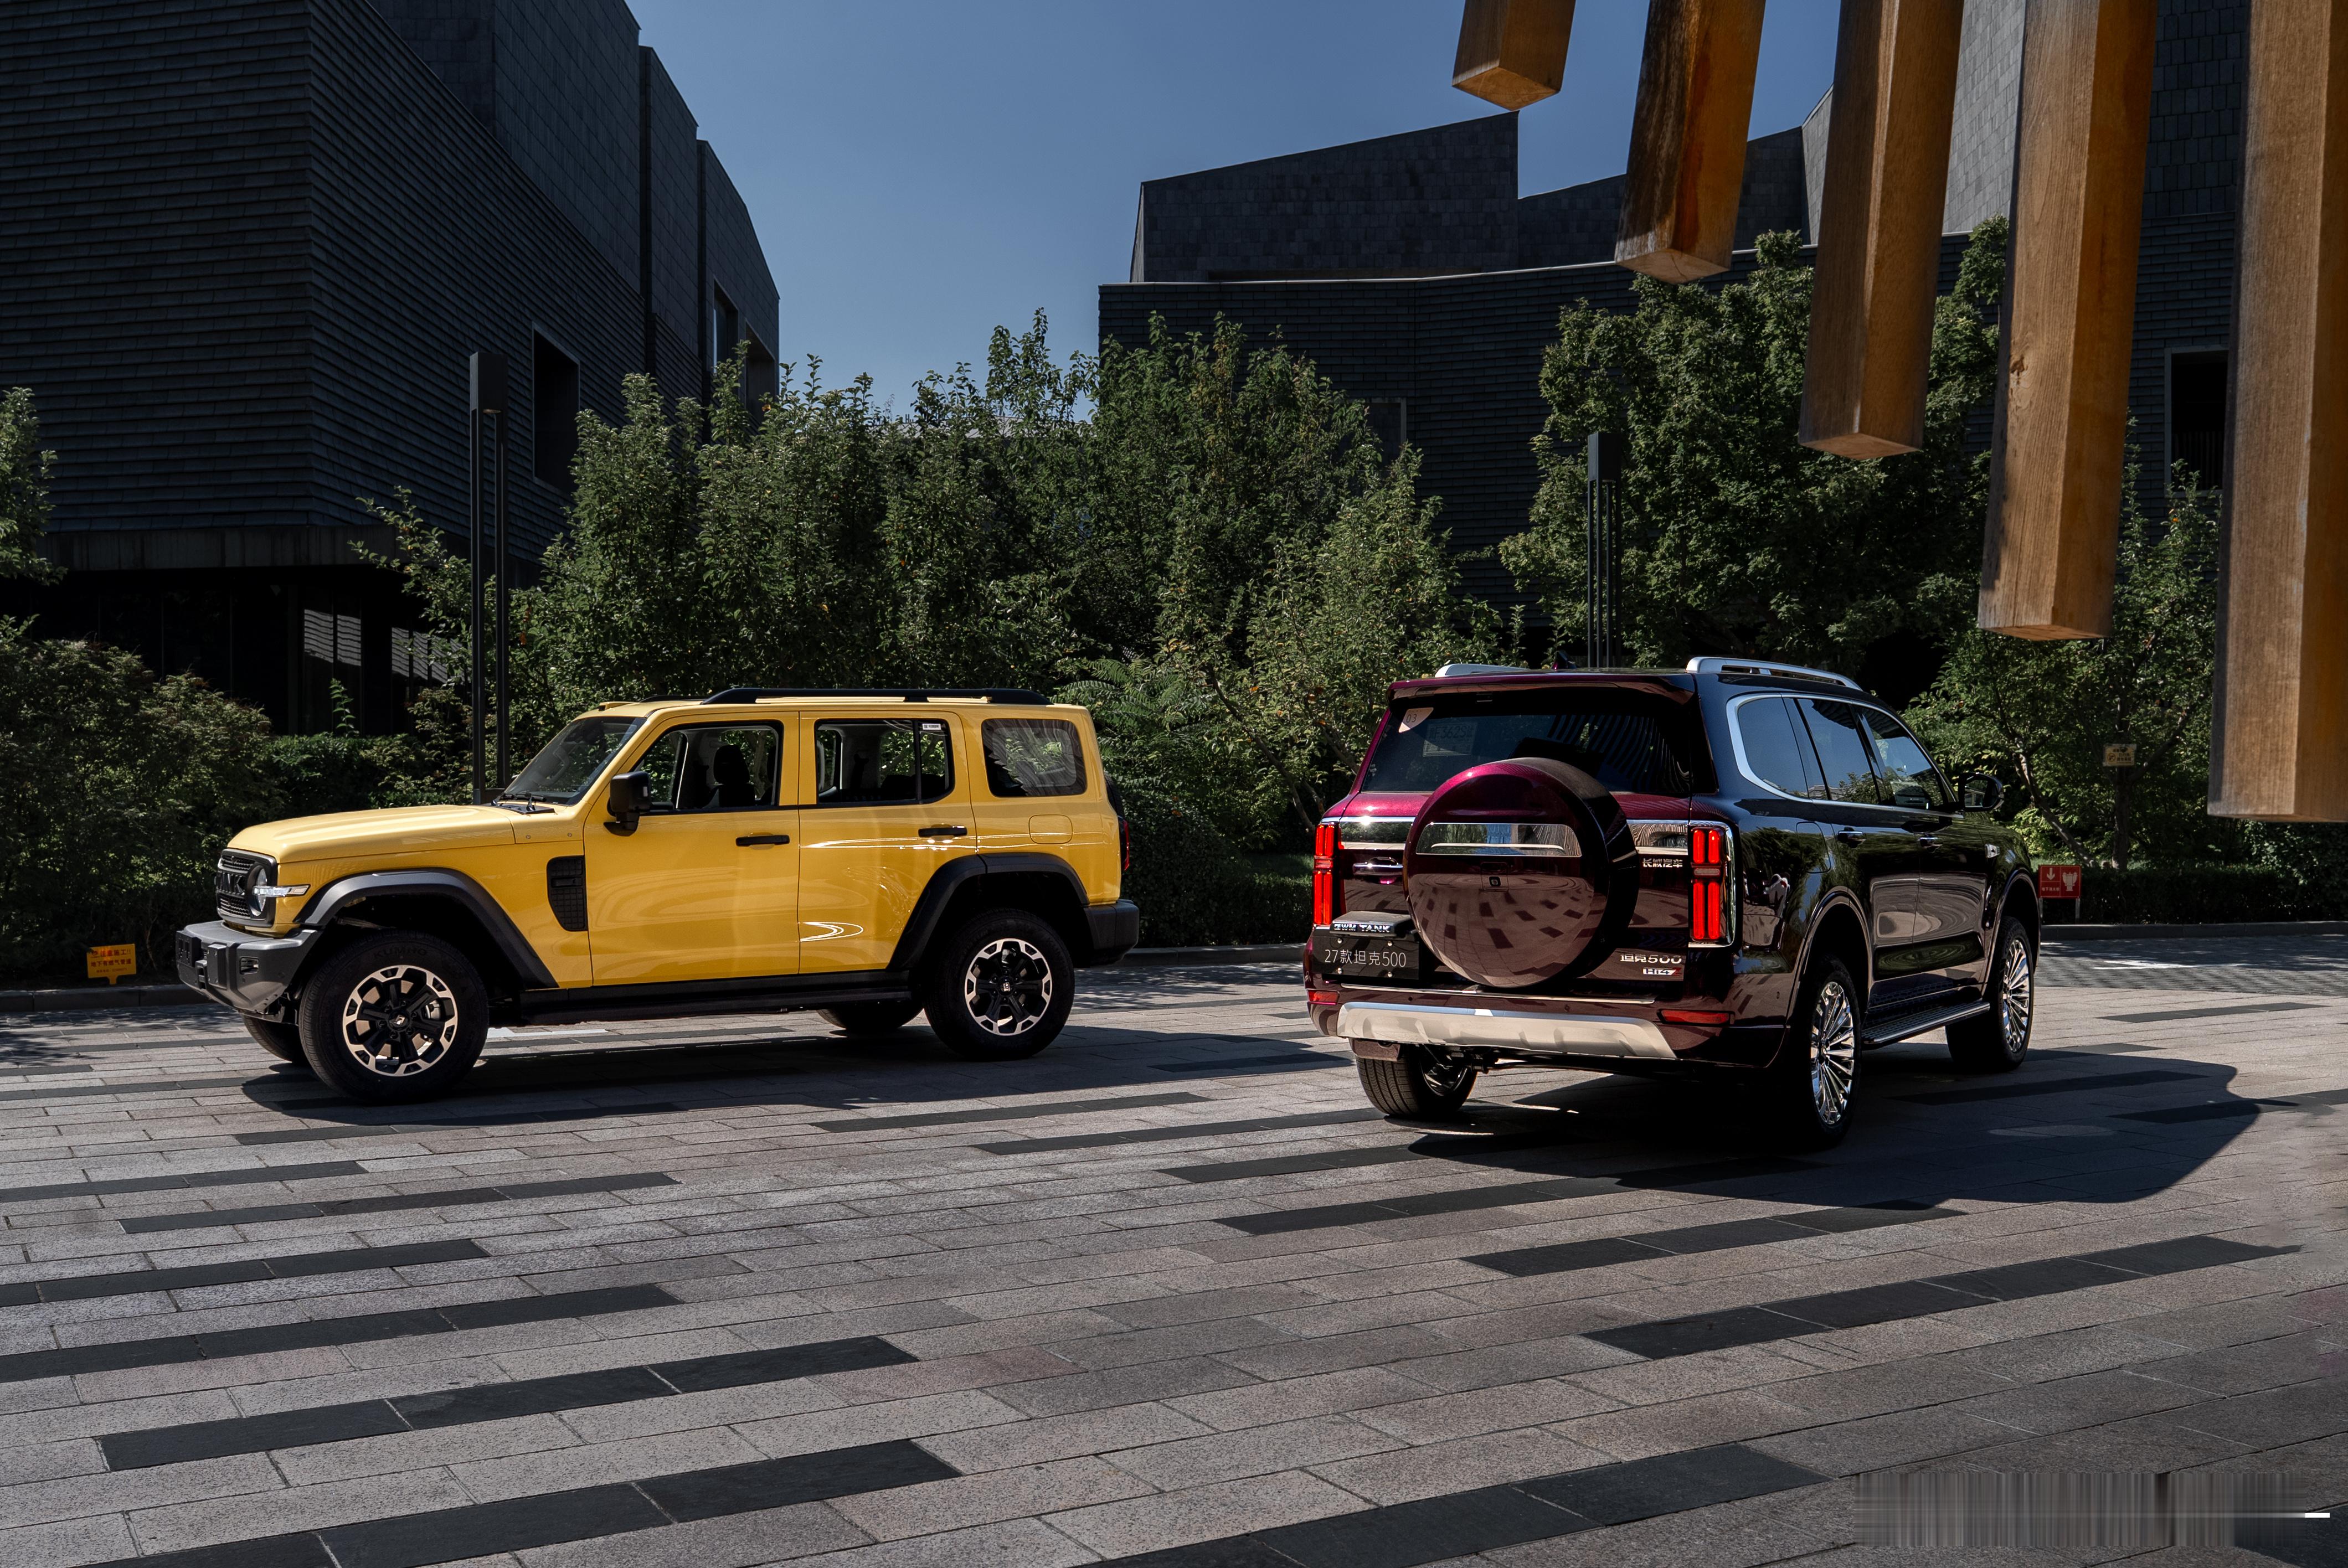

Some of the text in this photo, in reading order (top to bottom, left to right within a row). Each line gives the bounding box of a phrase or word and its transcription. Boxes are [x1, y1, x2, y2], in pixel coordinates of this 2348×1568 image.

[1405, 713, 1418, 723] 03
[1642, 858, 1683, 868] 长城汽车
[1359, 924, 1390, 933] TANK
[373, 946, 427, 958] KUMHO
[1325, 949, 1407, 967] 27款坦克500
[1620, 953, 1682, 964] 坦克500
